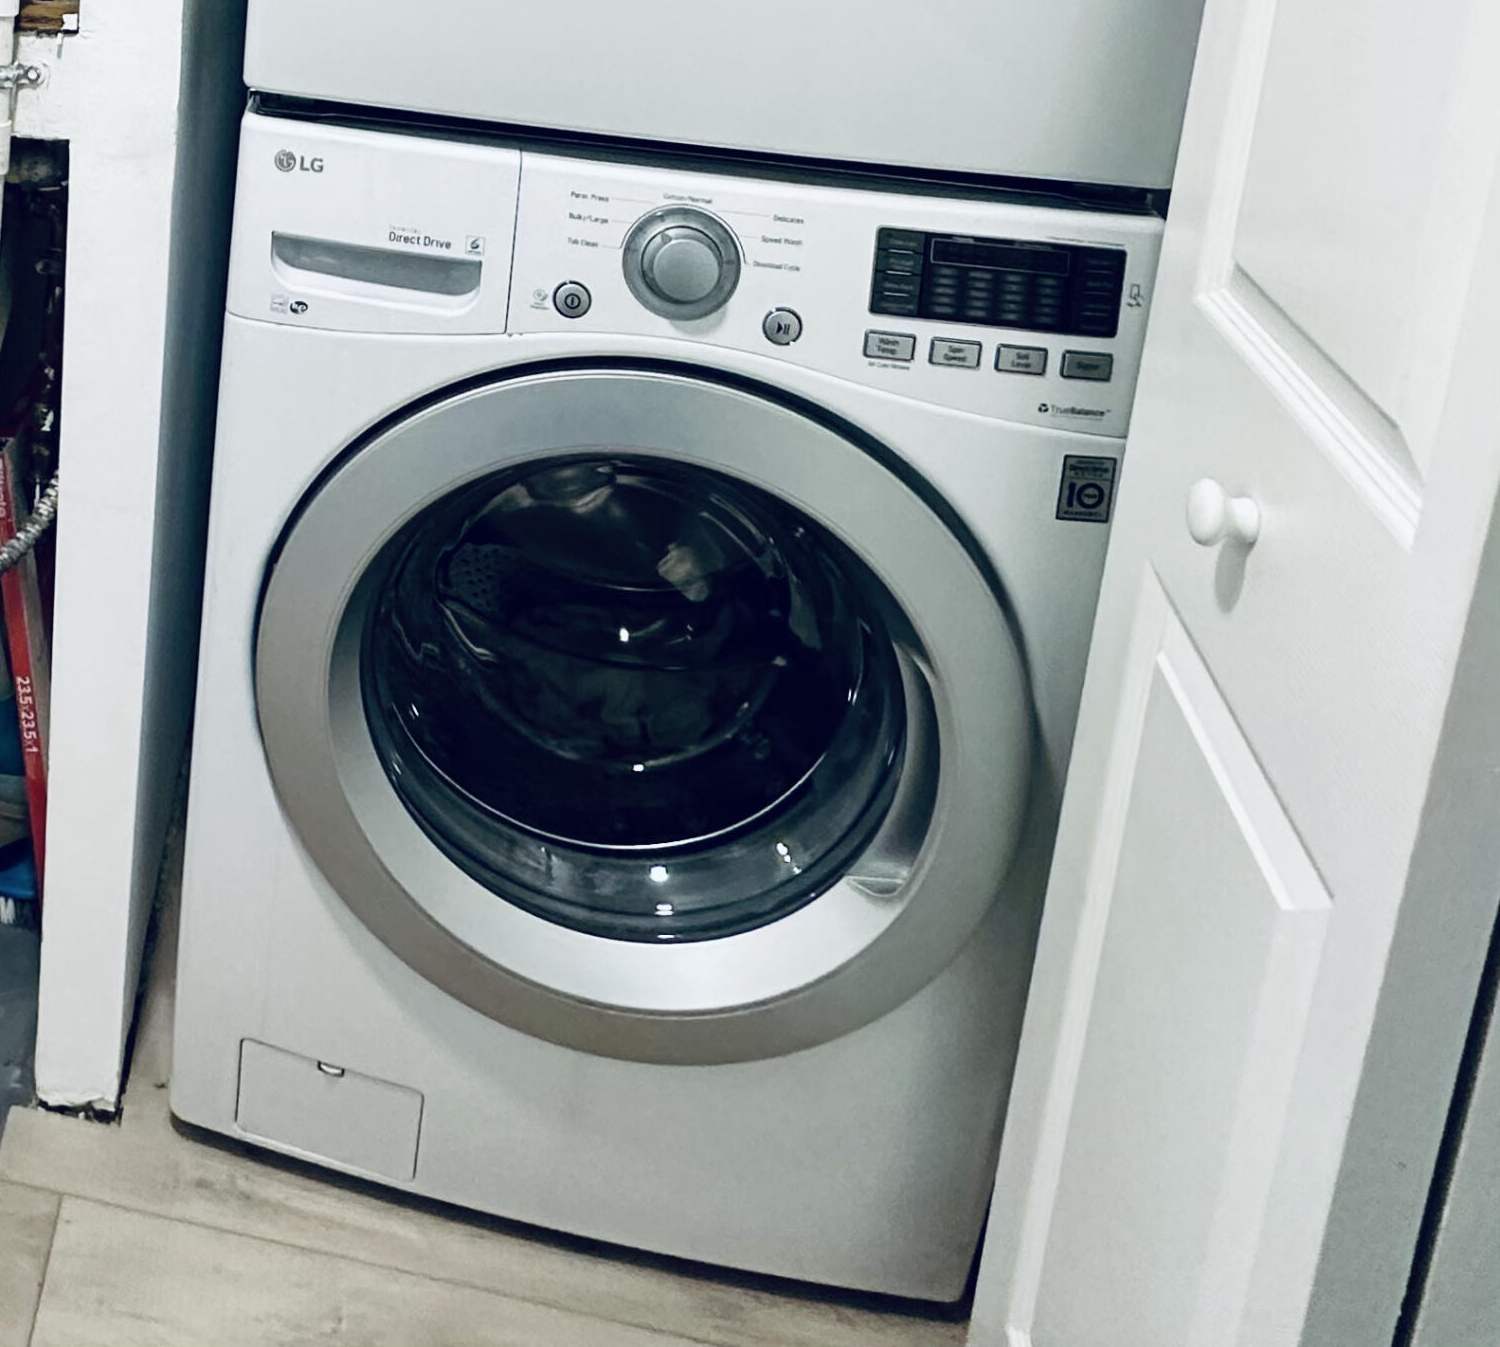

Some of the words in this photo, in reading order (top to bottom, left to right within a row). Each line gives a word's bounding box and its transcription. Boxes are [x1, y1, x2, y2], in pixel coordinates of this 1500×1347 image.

[300, 155, 324, 173] LG
[388, 231, 421, 245] Direct
[423, 236, 452, 250] Drive
